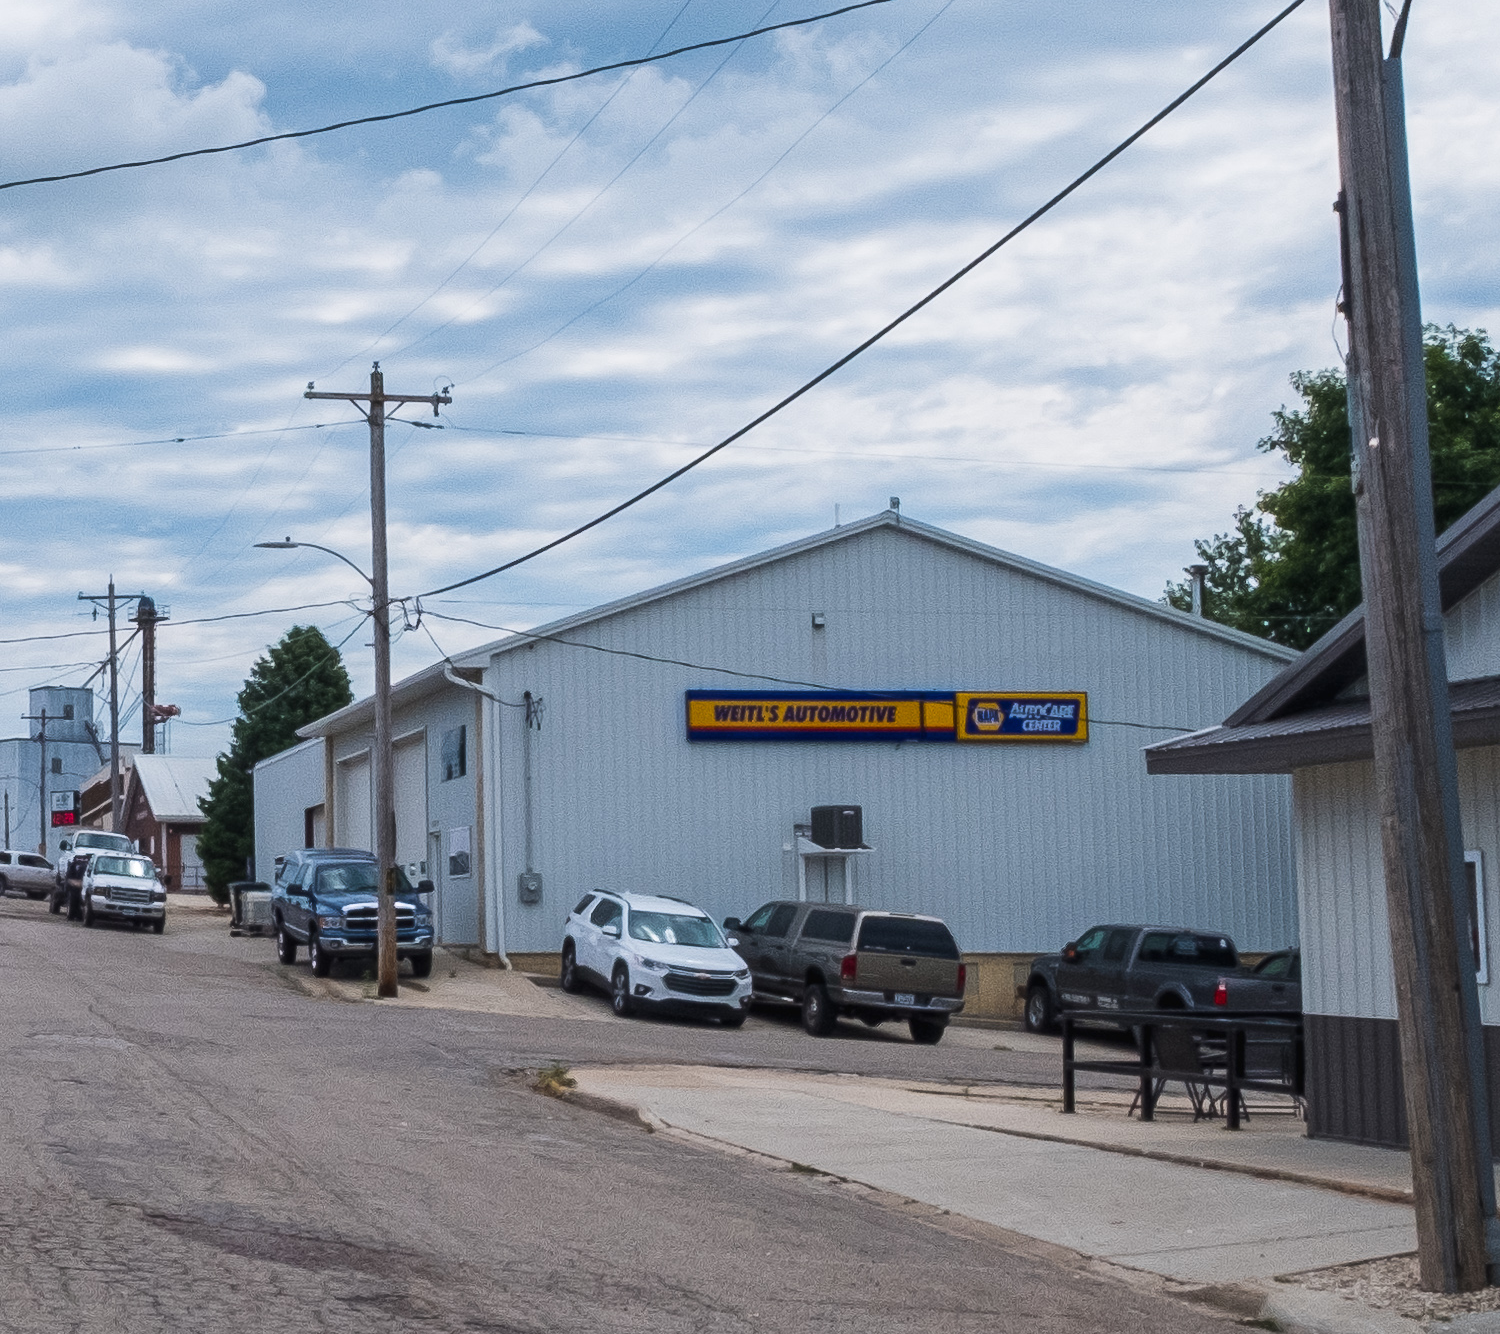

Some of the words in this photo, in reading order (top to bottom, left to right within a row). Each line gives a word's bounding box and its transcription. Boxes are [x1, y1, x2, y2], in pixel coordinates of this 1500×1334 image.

[714, 705, 779, 723] WEITL'S
[783, 705, 897, 723] AUTOMOTIVE
[1022, 720, 1061, 731] CENTER
